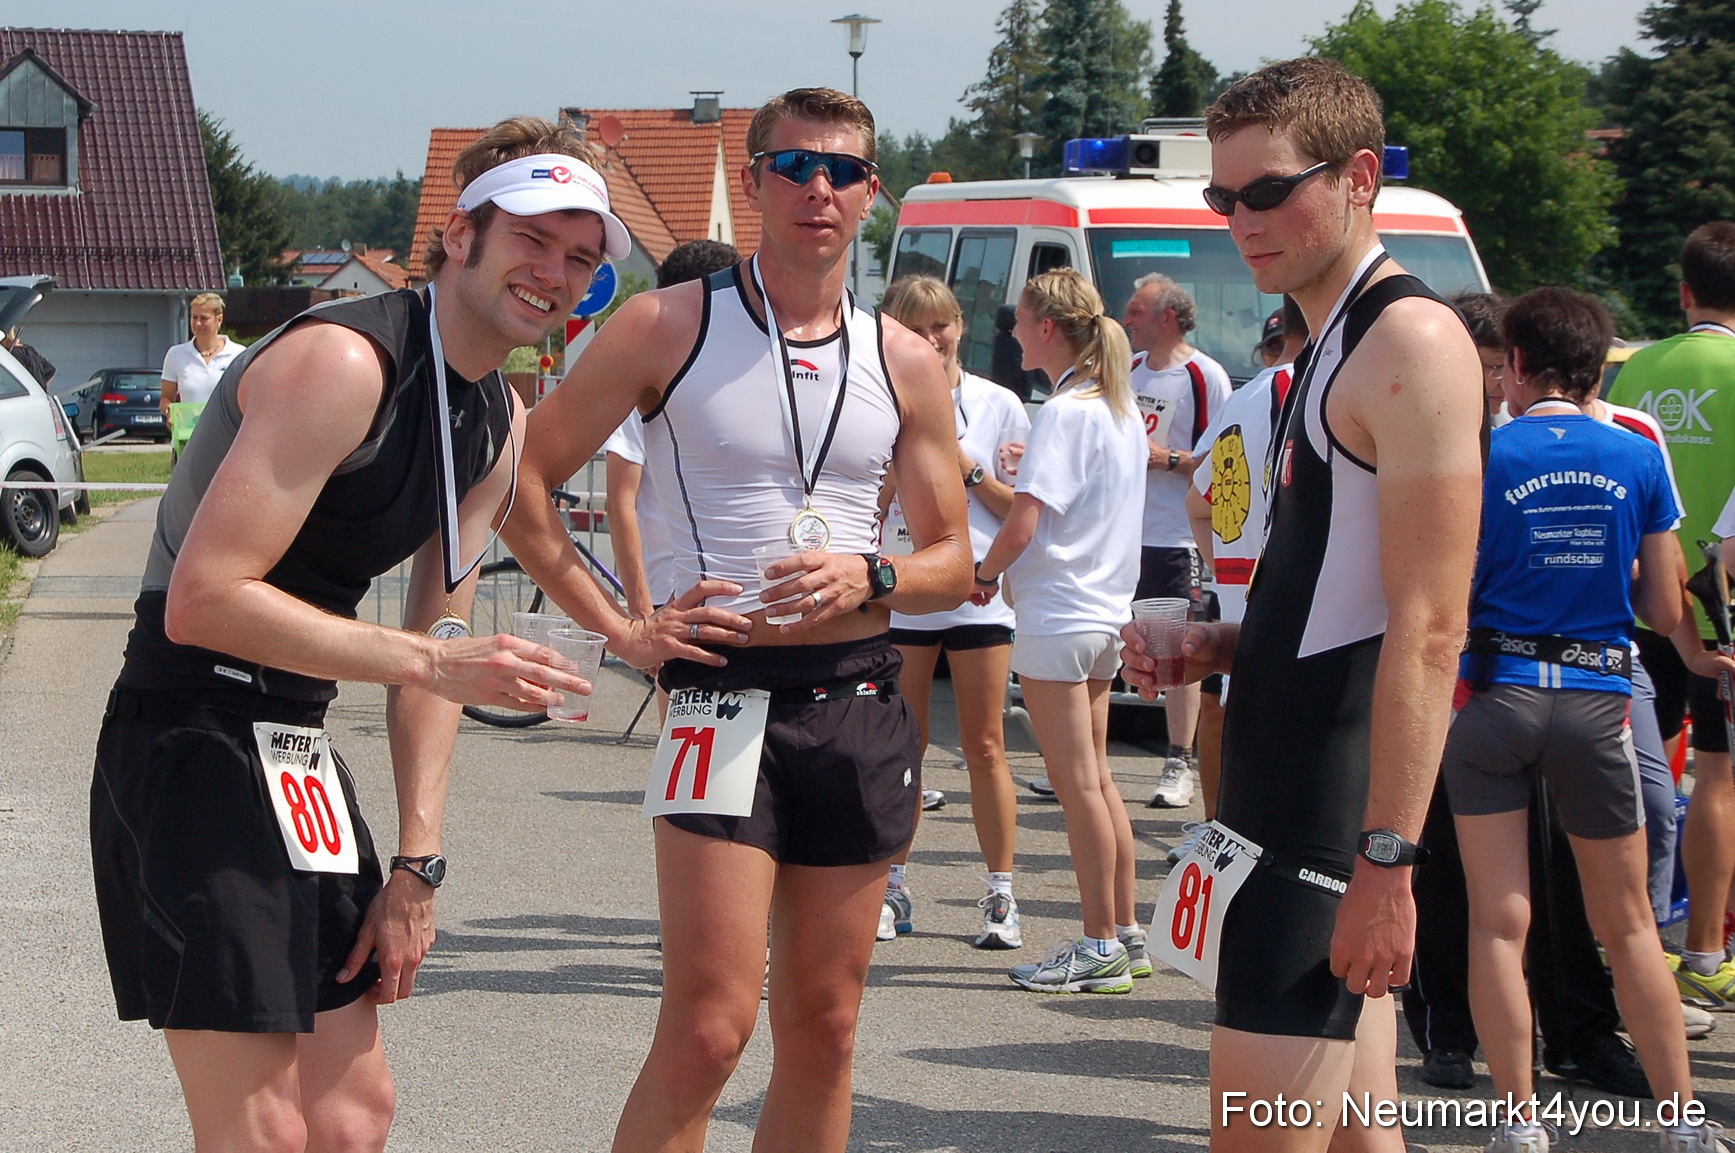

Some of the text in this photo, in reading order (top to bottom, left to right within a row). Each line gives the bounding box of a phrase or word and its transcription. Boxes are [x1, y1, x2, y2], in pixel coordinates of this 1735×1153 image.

[792, 370, 820, 382] infit
[1637, 388, 1718, 432] AOK
[1140, 410, 1160, 437] 2
[1504, 470, 1628, 506] funrunners
[1522, 504, 1613, 515] www.funrunners-neumarkt.de
[1533, 527, 1603, 540] Neumarkter Tagblatt
[1543, 553, 1604, 565] rundschau
[270, 731, 312, 754] MEYER
[270, 749, 308, 767] WERBUNG
[664, 726, 716, 801] 71
[280, 771, 341, 856] 80
[1200, 826, 1226, 851] EYER
[1170, 862, 1214, 962] 81
